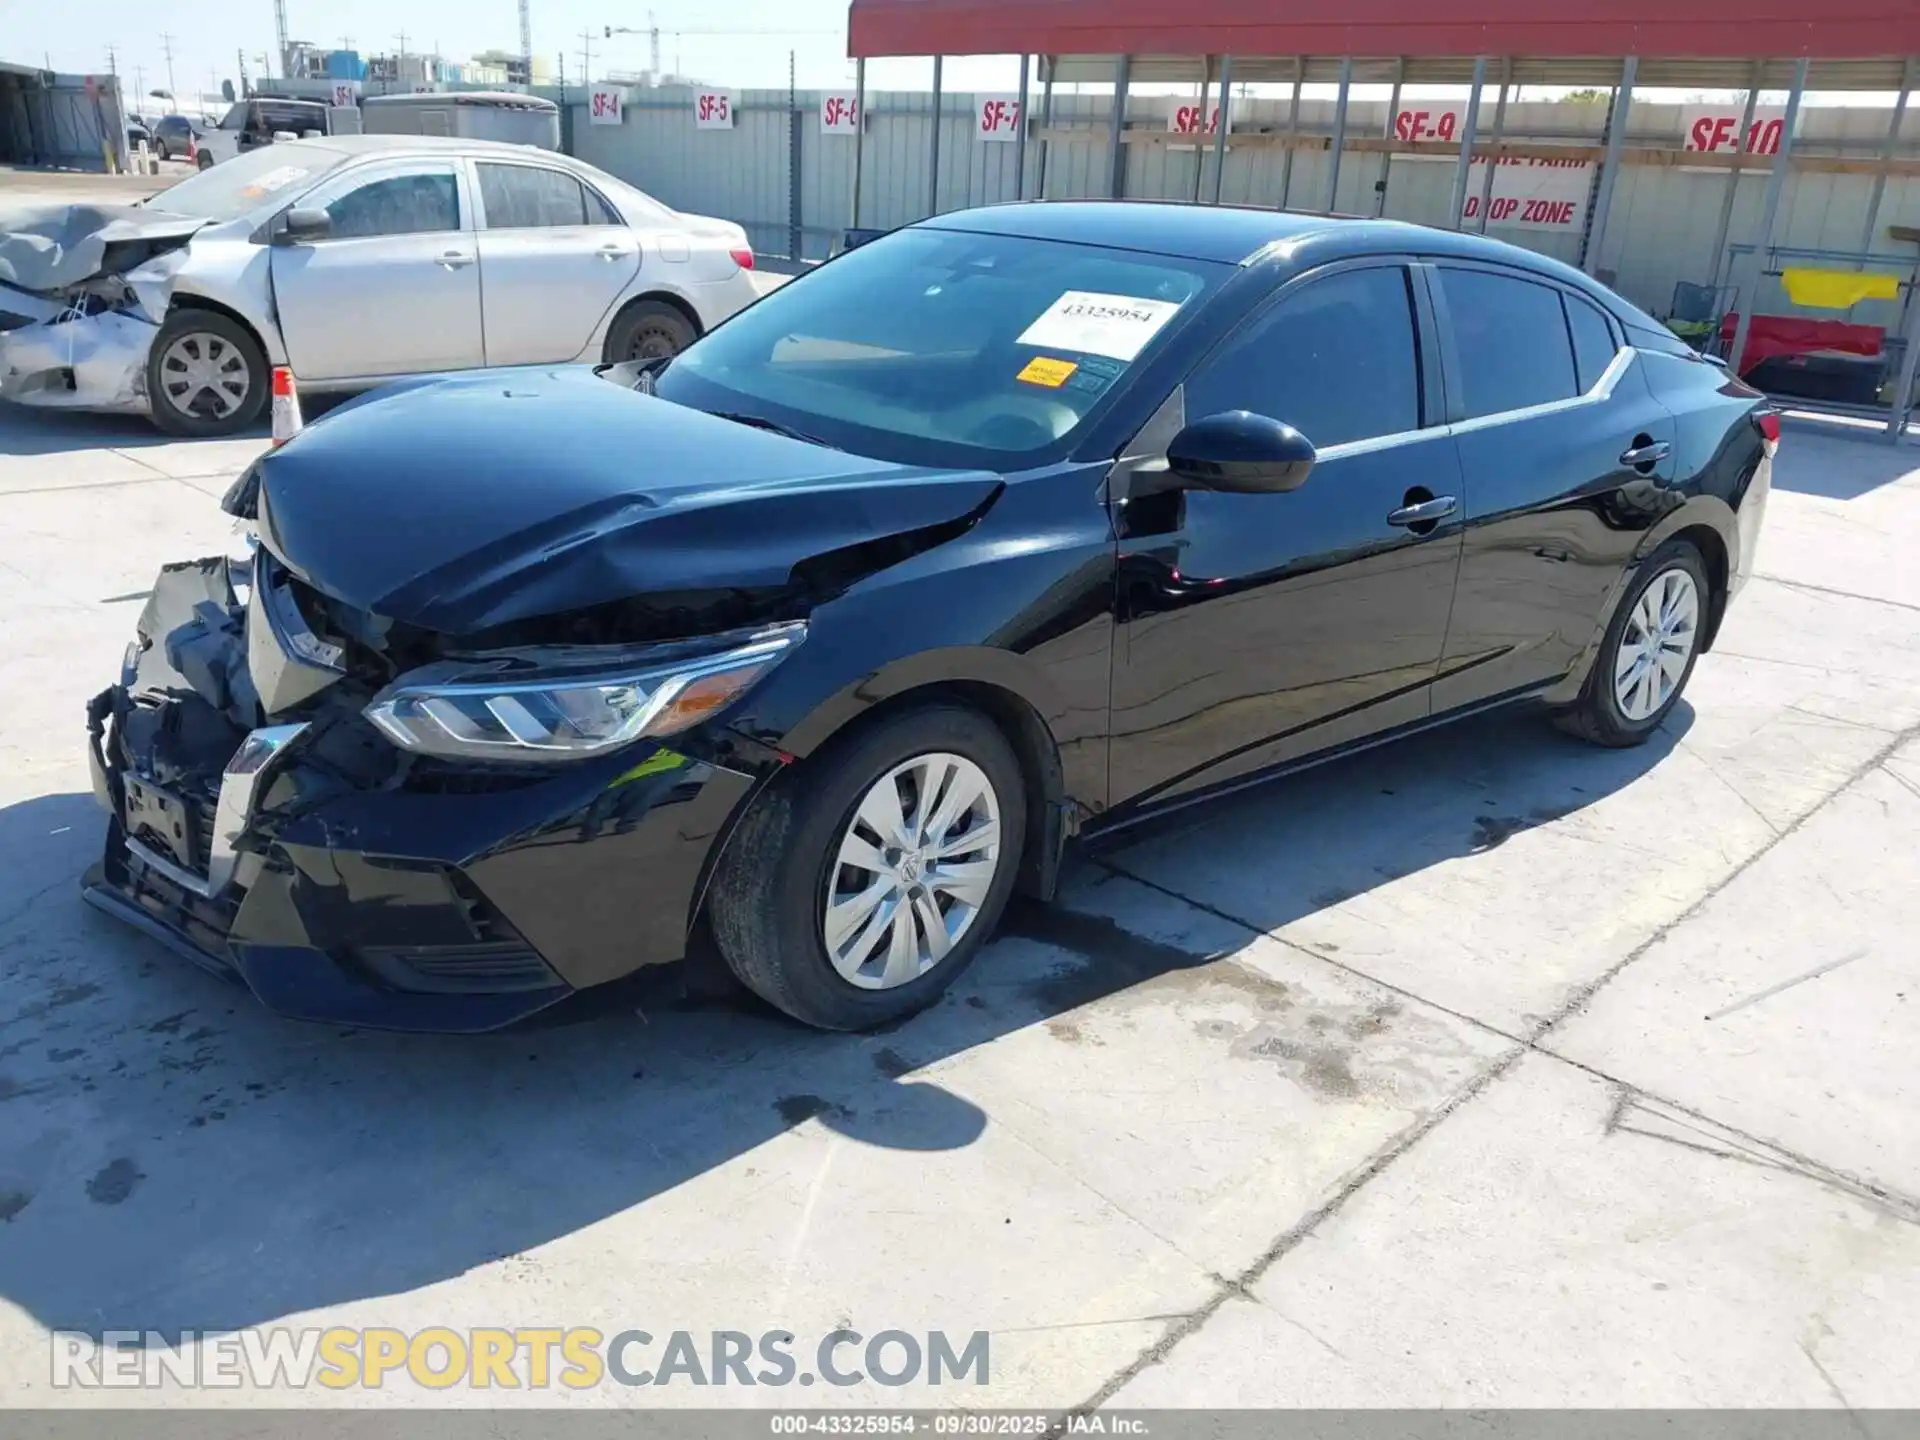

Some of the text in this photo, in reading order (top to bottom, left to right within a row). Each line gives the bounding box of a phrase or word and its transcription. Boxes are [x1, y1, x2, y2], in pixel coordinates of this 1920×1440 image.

[593, 93, 618, 117] SF-4
[699, 95, 728, 121] SF-5
[982, 101, 1020, 131] SF-7
[1394, 111, 1456, 141] SF-9
[1686, 117, 1784, 154] SF-10
[1463, 196, 1576, 224] DOP ZONE
